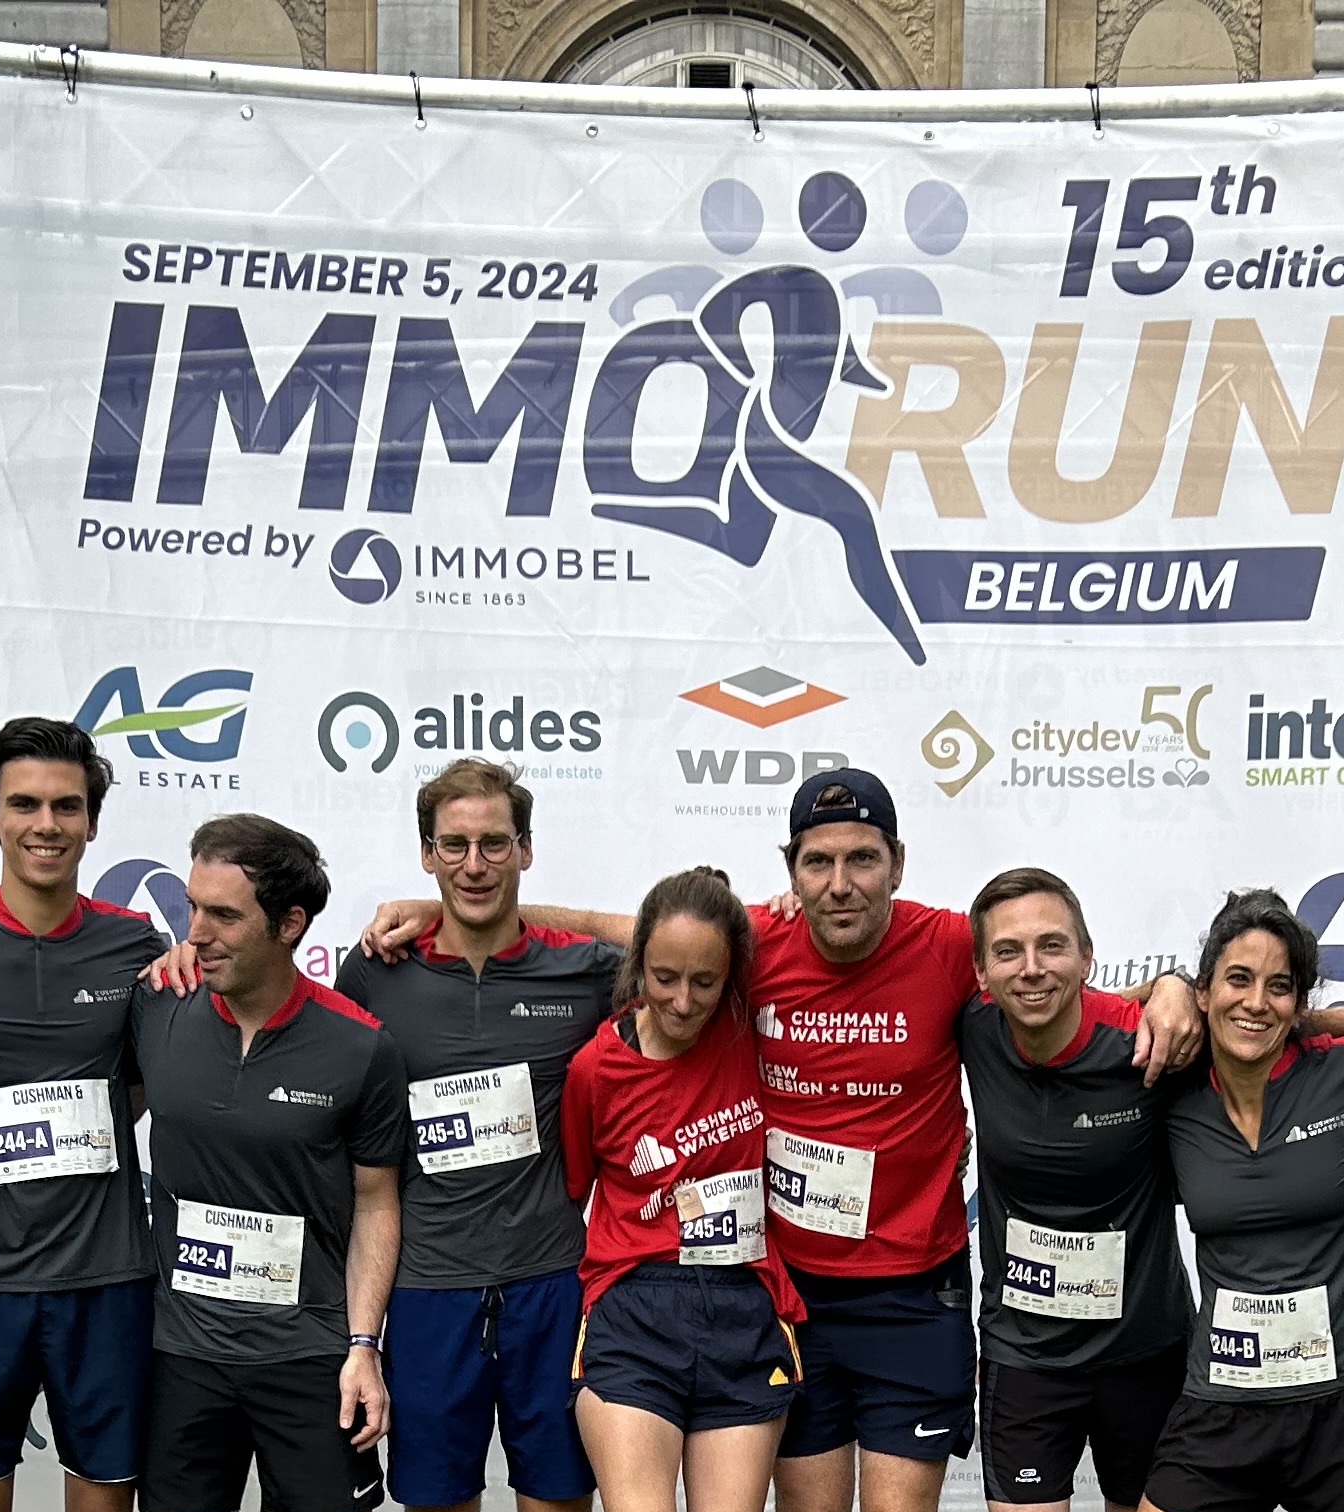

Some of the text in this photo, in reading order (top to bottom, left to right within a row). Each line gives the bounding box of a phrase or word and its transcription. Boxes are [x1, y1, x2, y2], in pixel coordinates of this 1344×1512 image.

[122, 242, 599, 305] SEPTEMBER 5, 2024
[77, 517, 315, 568] Powered by
[413, 543, 651, 584] IMMOBEL
[414, 590, 527, 607] SINCE 1863
[963, 559, 1240, 614] BELGIUM
[72, 665, 254, 763] AG
[413, 693, 602, 753] alides
[1012, 720, 1140, 757] citydev
[138, 770, 241, 790] ESTATE
[555, 766, 602, 781] estate
[1001, 757, 1155, 788] .brussels
[1245, 766, 1329, 787] SMART
[675, 805, 759, 816] WAREHOUSES
[791, 1011, 907, 1028] CUSHMAN &
[789, 1026, 908, 1043] WAKEFIELD
[13, 1085, 83, 1105] CUSHMAN &
[434, 1073, 502, 1098] CUSHMAN &
[767, 1075, 902, 1096] DESIGN BUILD
[417, 1119, 467, 1145] 245-B
[674, 1097, 751, 1143] CUSHMAN
[784, 1137, 834, 1165] CUSHMAN
[703, 1175, 753, 1198] CUSHMAN
[769, 1166, 802, 1198] 243-B
[206, 1209, 273, 1233] CUSHMAN &
[683, 1216, 733, 1239] 245-C
[1030, 1229, 1083, 1251] CUSHMAN
[178, 1243, 227, 1271] 242-A
[1007, 1260, 1051, 1289] 244-C
[1232, 1296, 1285, 1315] CUSHMAN
[1209, 1333, 1255, 1359] 244-B
